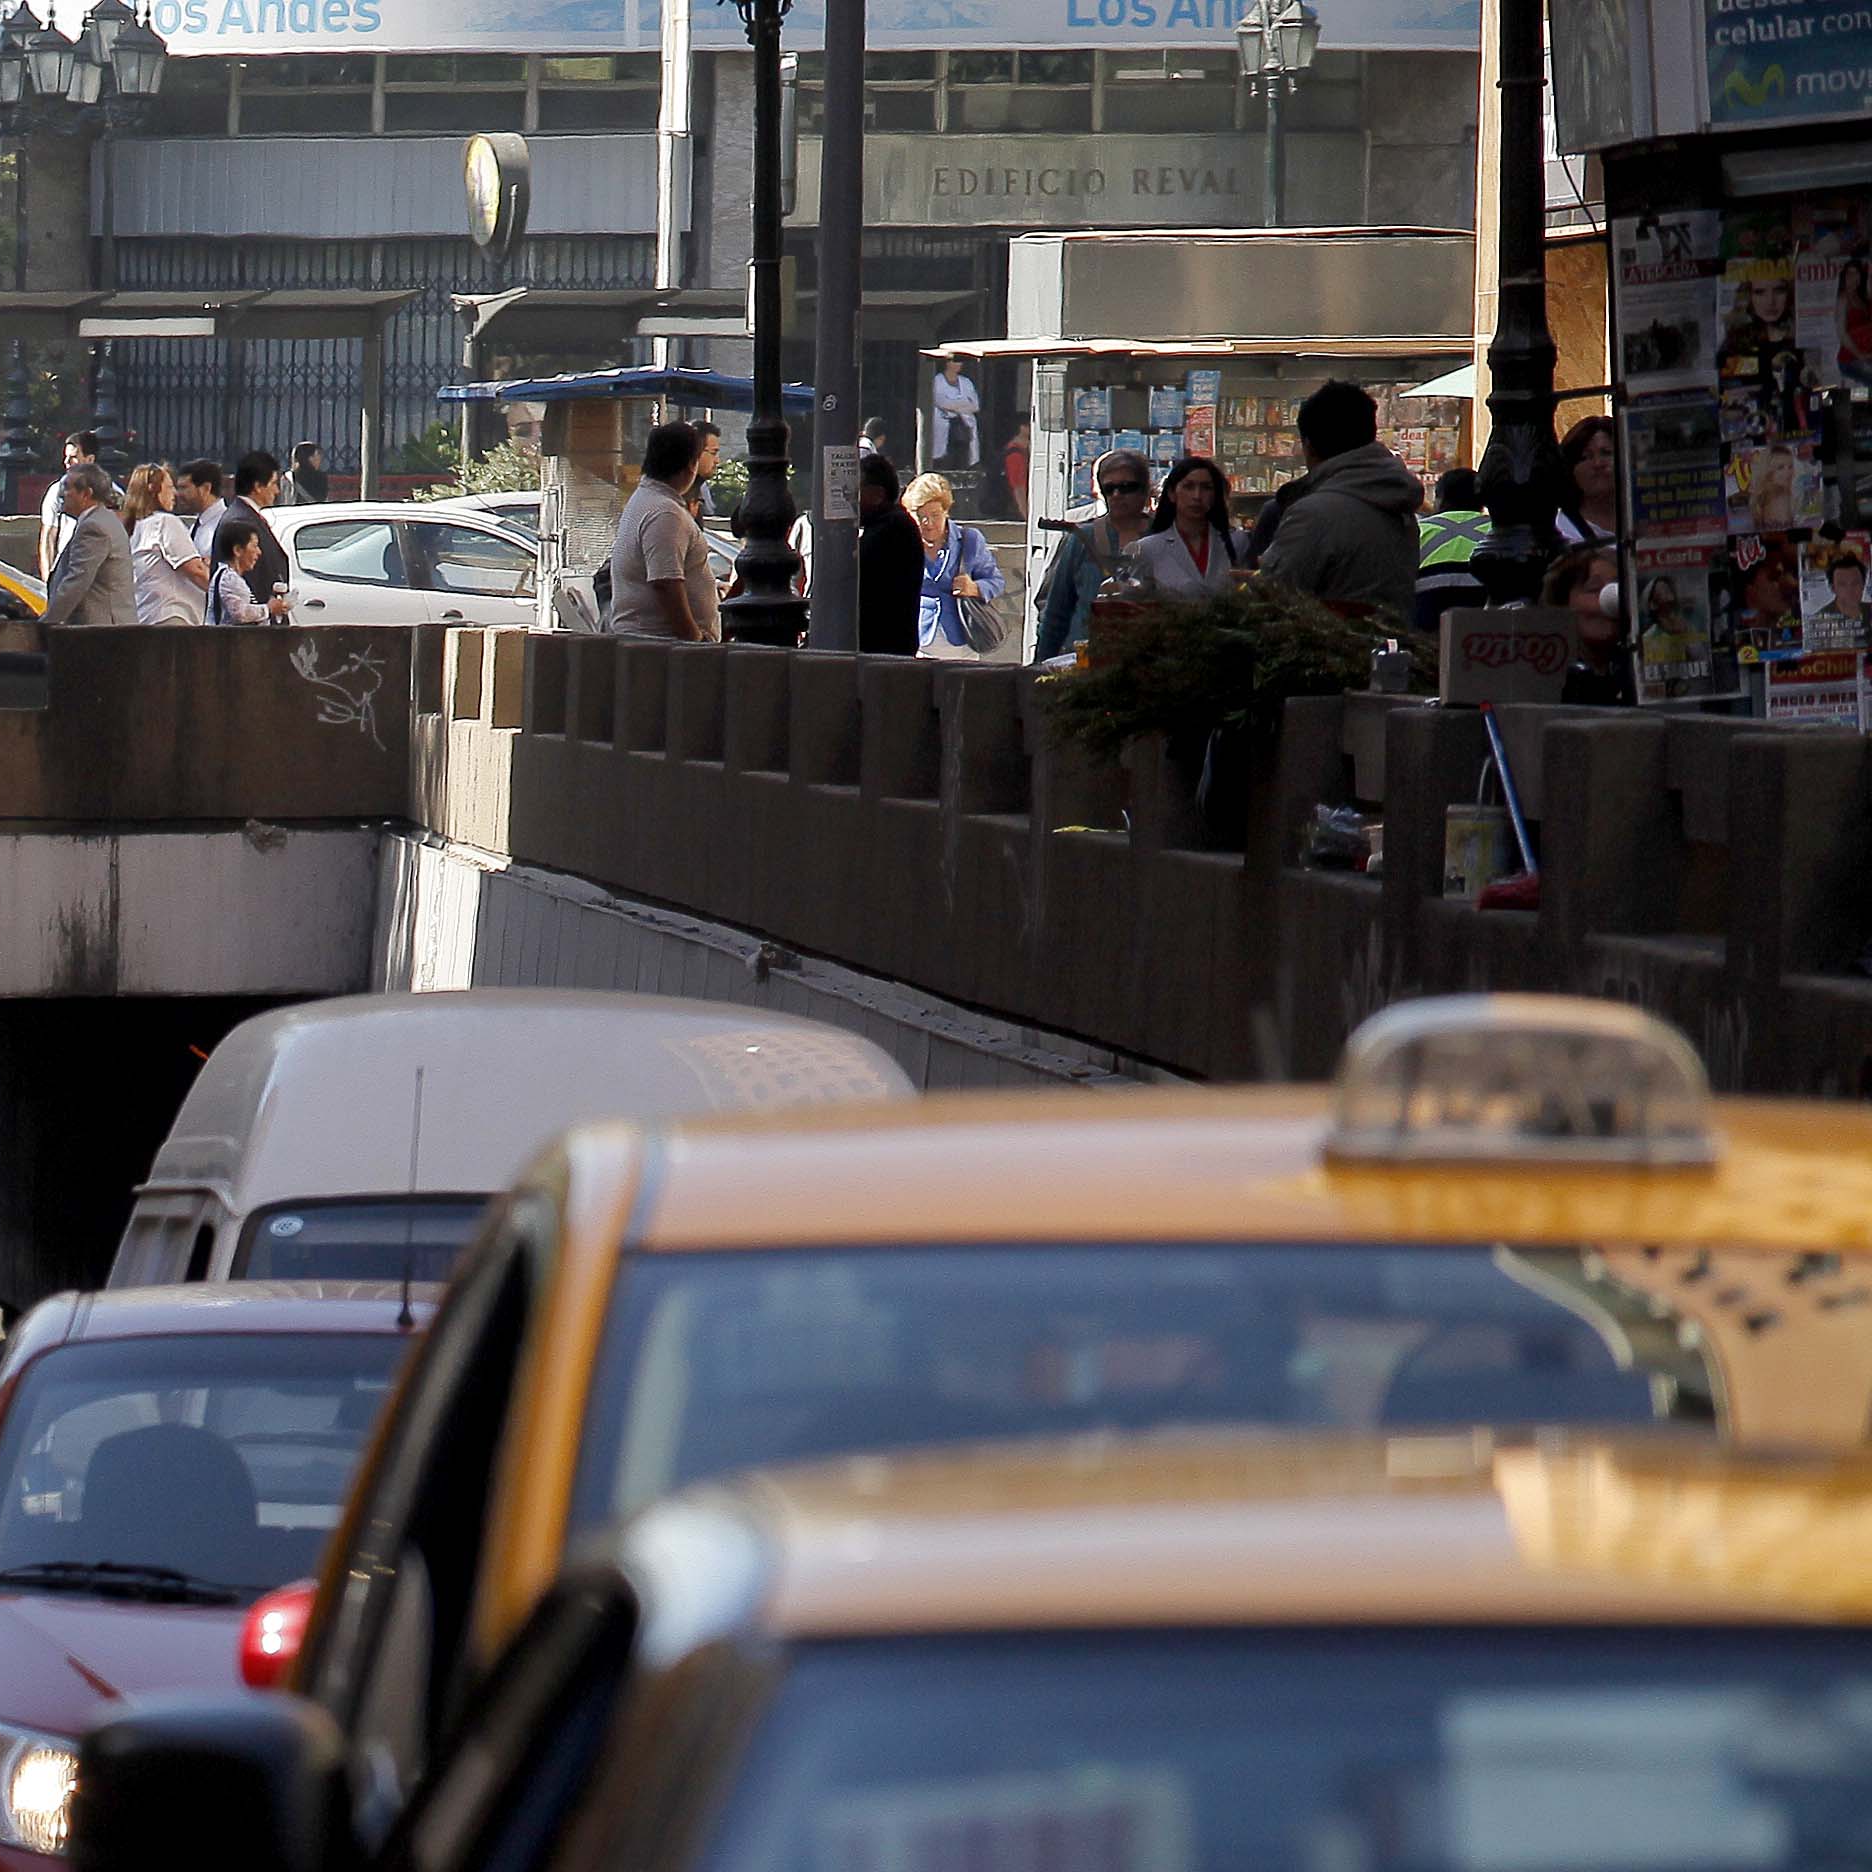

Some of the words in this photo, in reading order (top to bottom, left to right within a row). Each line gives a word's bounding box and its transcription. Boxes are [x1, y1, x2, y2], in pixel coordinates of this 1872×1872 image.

[142, 0, 207, 34] os
[217, 0, 382, 34] Andes
[1066, 0, 1156, 28] Los
[1714, 14, 1815, 46] celular
[932, 166, 1106, 197] EDIFICIO
[1131, 165, 1250, 197] REVAL
